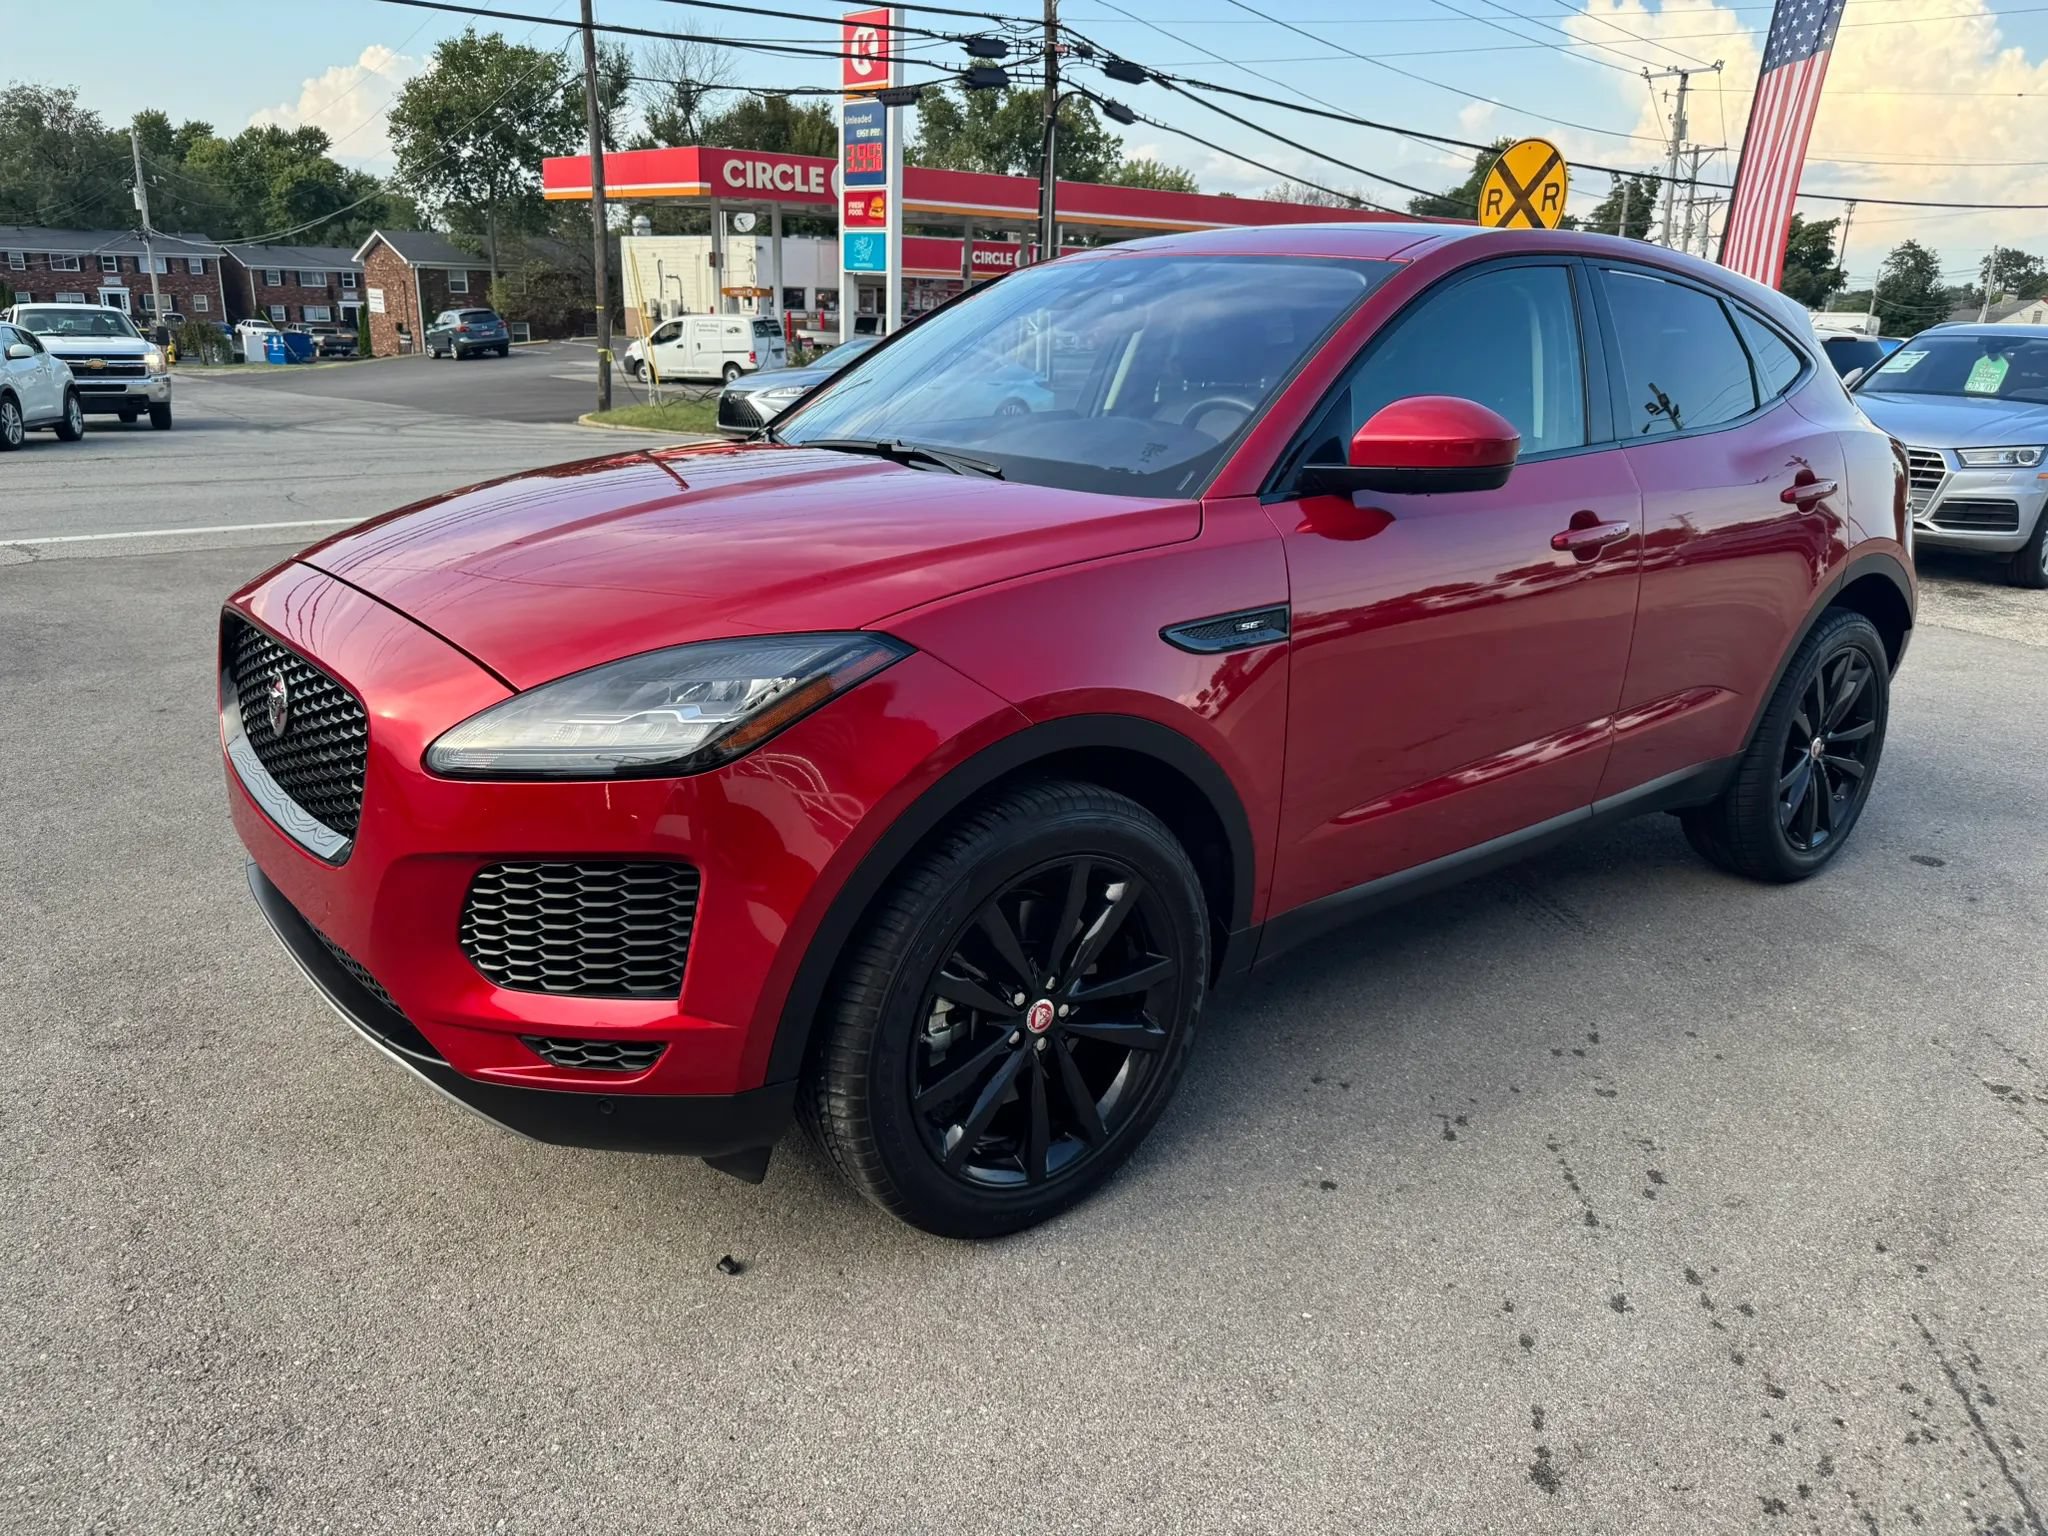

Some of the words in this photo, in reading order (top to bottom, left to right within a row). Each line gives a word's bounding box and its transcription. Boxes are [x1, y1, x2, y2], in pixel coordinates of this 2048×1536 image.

[844, 114, 872, 125] Unleaded
[723, 159, 825, 194] CIRCLE
[848, 201, 865, 209] FRESH
[1485, 188, 1503, 216] R
[1541, 182, 1560, 212] R
[972, 250, 1013, 266] CIRCLE
[1240, 620, 1263, 630] SE
